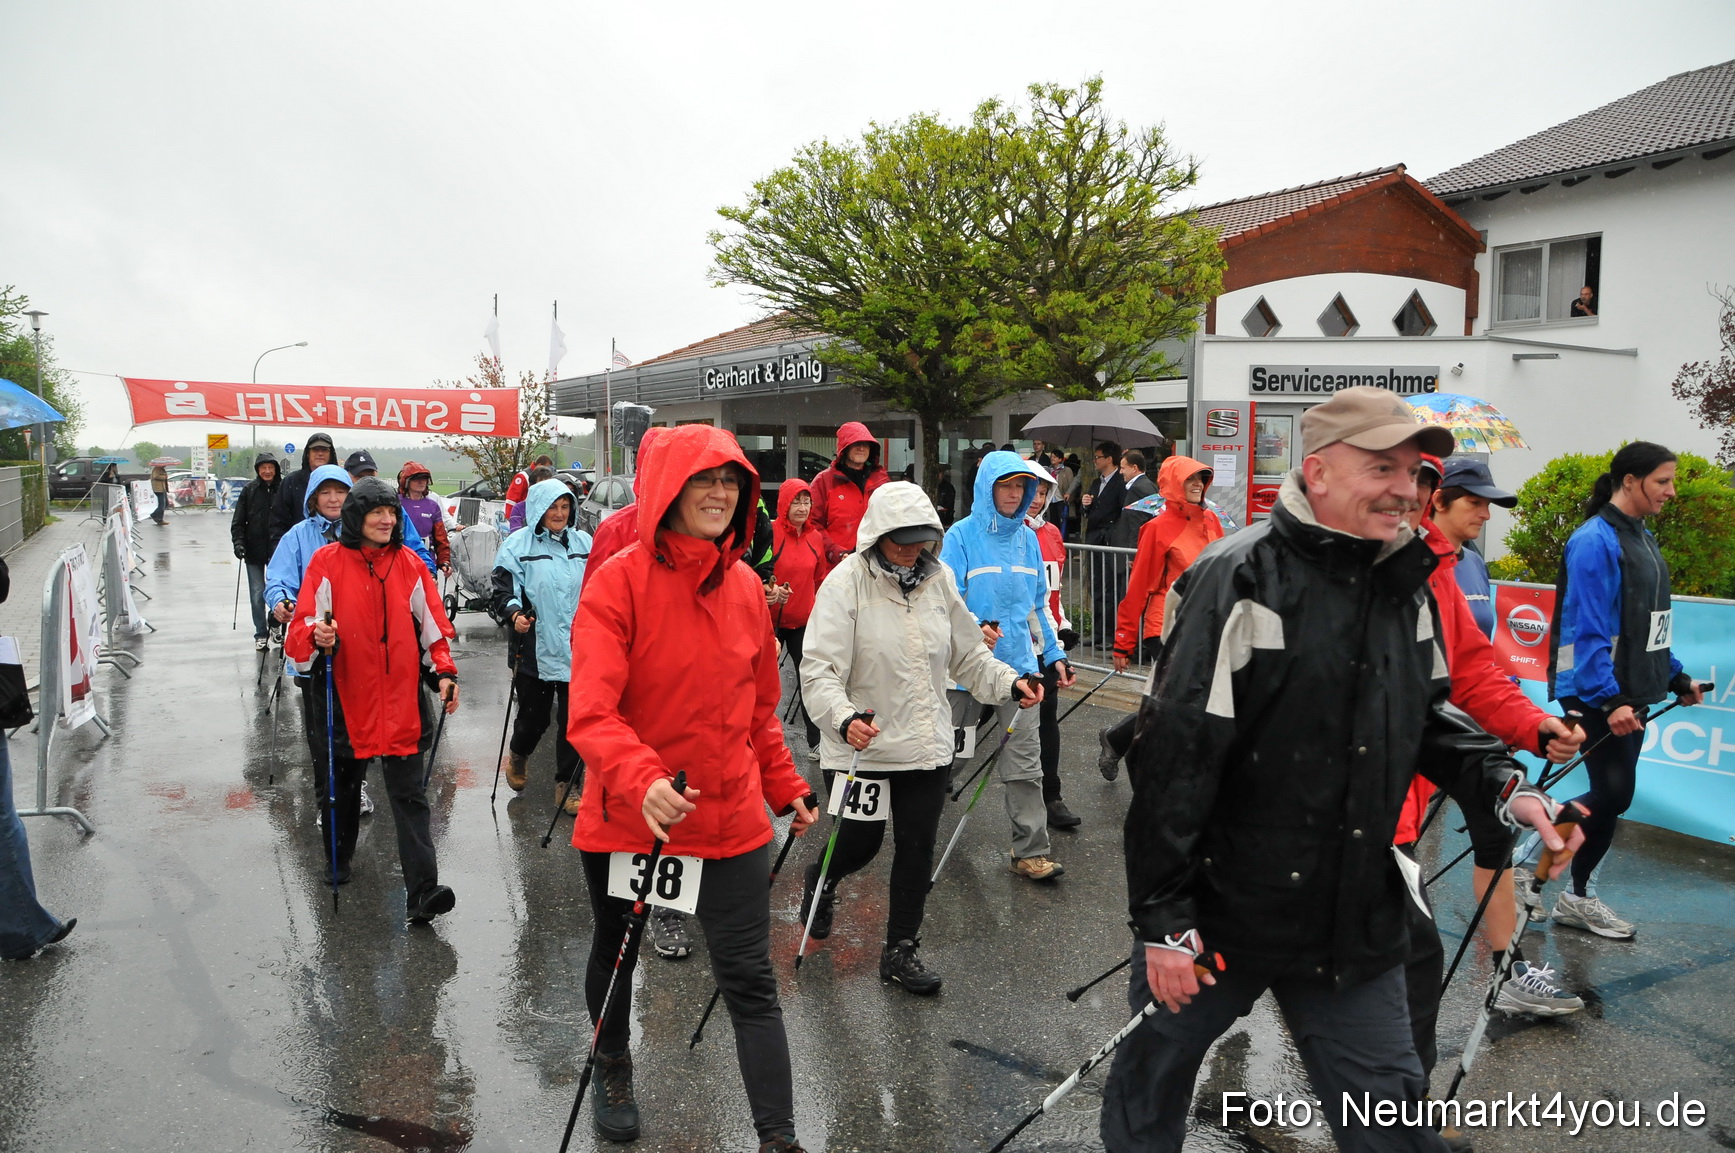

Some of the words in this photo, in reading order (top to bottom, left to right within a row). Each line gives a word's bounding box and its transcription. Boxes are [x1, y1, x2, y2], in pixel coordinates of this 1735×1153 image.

[705, 363, 760, 390] Gerhart
[765, 361, 775, 383] &
[779, 354, 823, 384] Jänig
[1252, 367, 1436, 393] Serviceannahme
[1201, 444, 1244, 452] SEAT
[1509, 620, 1545, 632] NISSAN
[1653, 613, 1671, 645] 29
[846, 781, 881, 817] 43
[629, 852, 684, 901] 38
